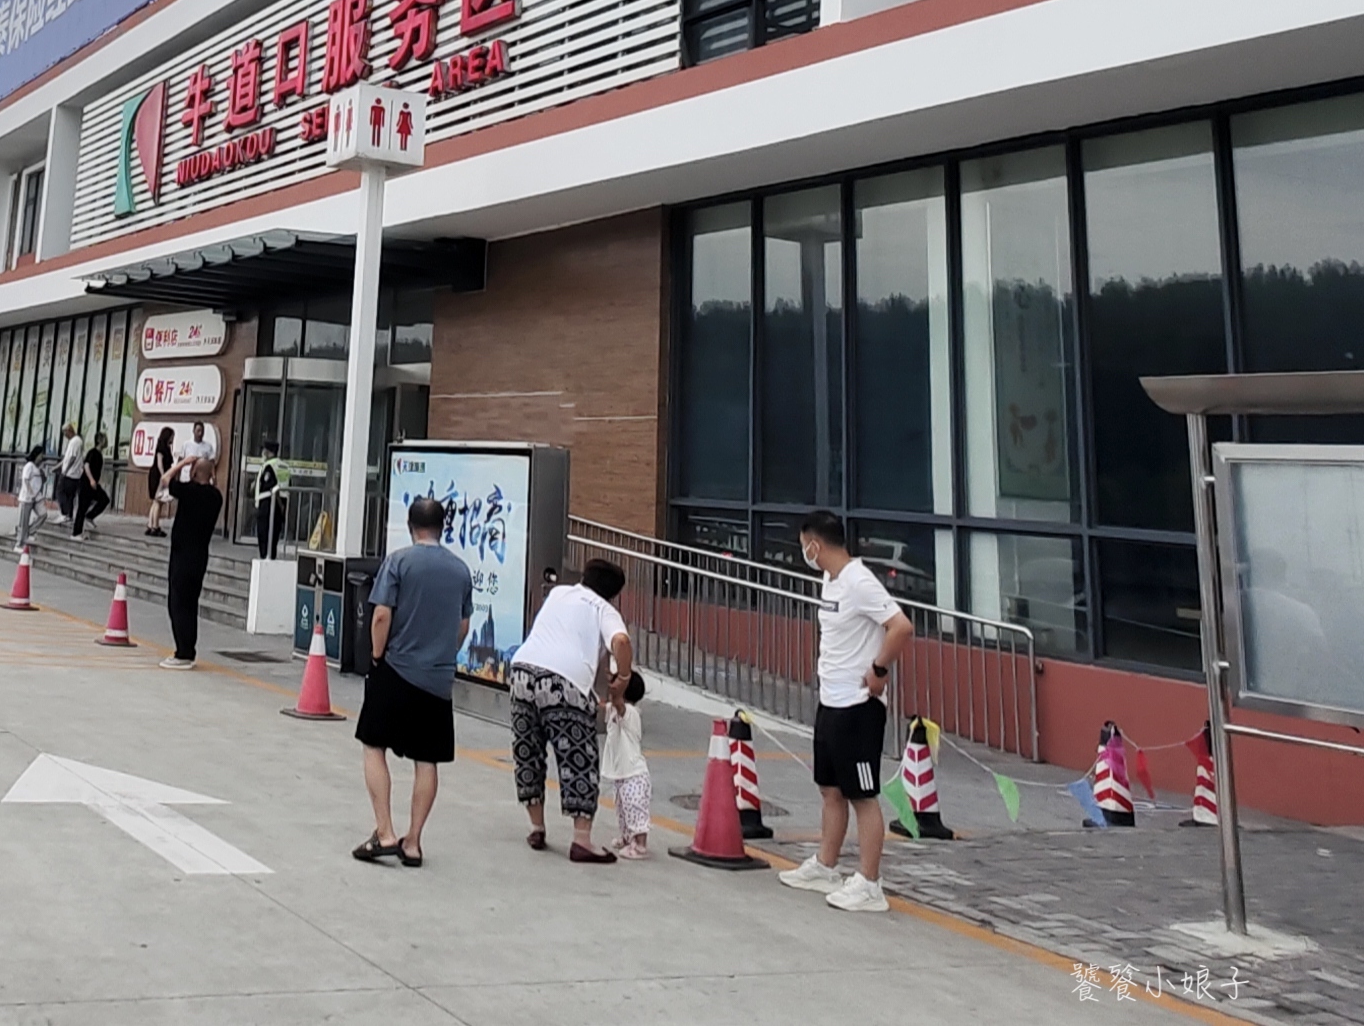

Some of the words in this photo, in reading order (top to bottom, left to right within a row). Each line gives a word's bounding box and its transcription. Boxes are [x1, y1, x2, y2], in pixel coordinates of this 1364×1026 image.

[176, 127, 277, 188] NIUDAOKOU
[428, 39, 512, 98] AREA
[155, 328, 178, 347] 便利店
[154, 379, 175, 404] 餐厅
